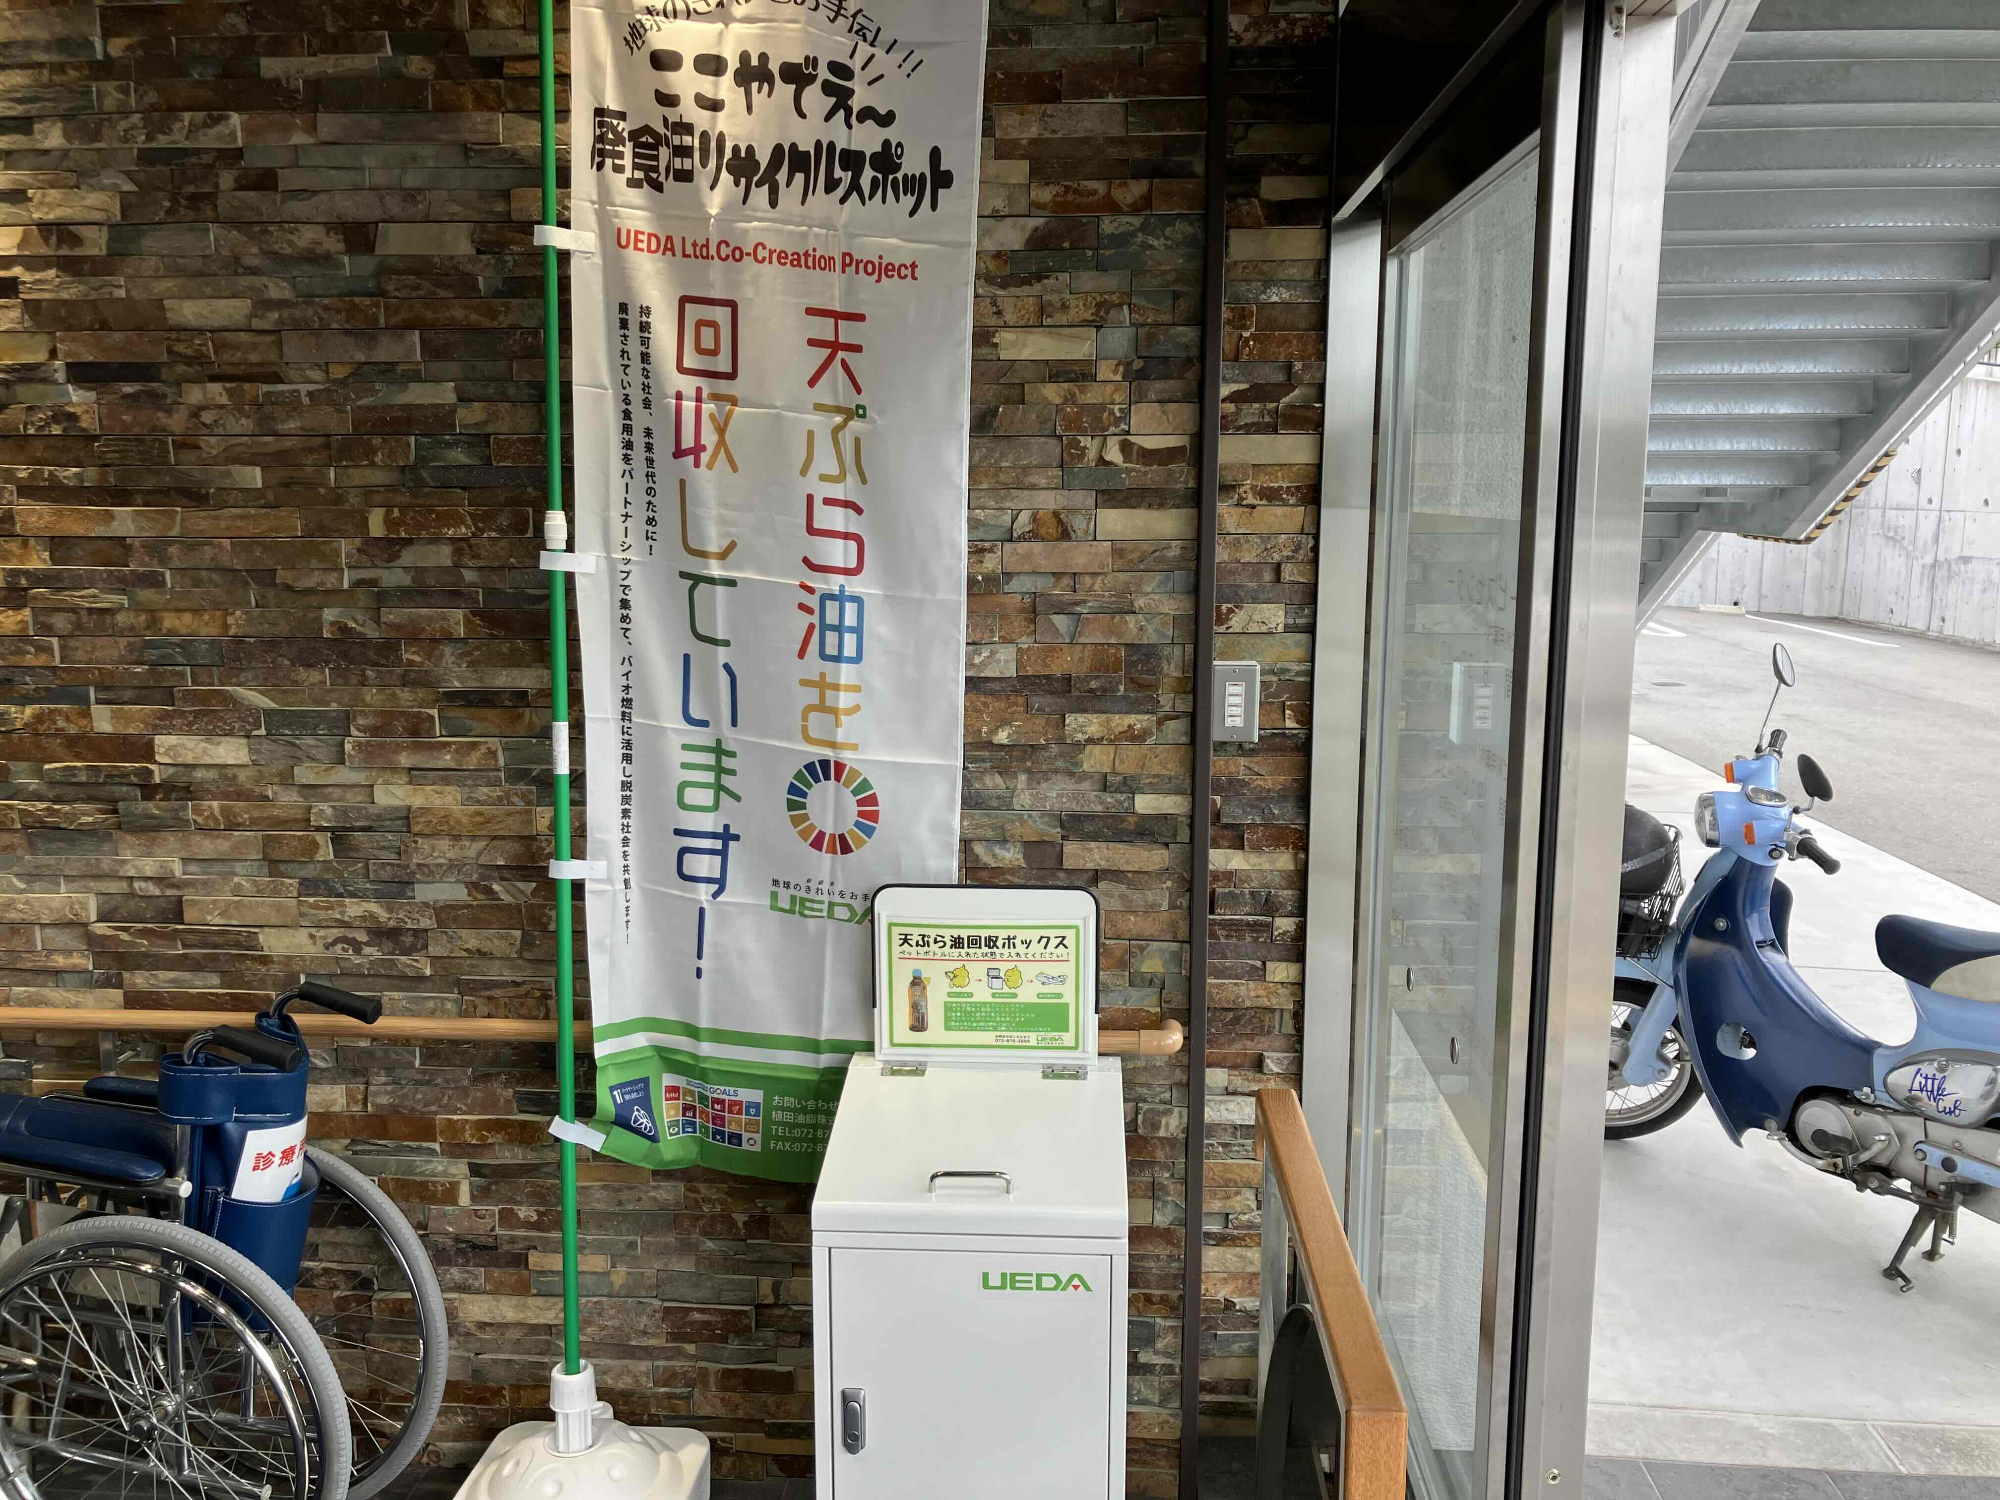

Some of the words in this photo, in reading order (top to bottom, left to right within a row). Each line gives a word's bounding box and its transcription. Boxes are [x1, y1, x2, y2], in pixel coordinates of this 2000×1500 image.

[591, 104, 954, 218] 廃食油リサイクルスポット
[615, 226, 676, 257] UEDA
[681, 232, 837, 273] Ltd.Co-Creation
[841, 251, 919, 284] Project
[797, 306, 868, 752] 天ぷら油を
[898, 933, 1069, 950] 天ぷら油回収ボックス
[708, 1086, 739, 1097] GOALS
[1908, 1067, 1960, 1103] Little
[1936, 1097, 1968, 1118] Cub
[981, 1271, 1093, 1292] UEDA
